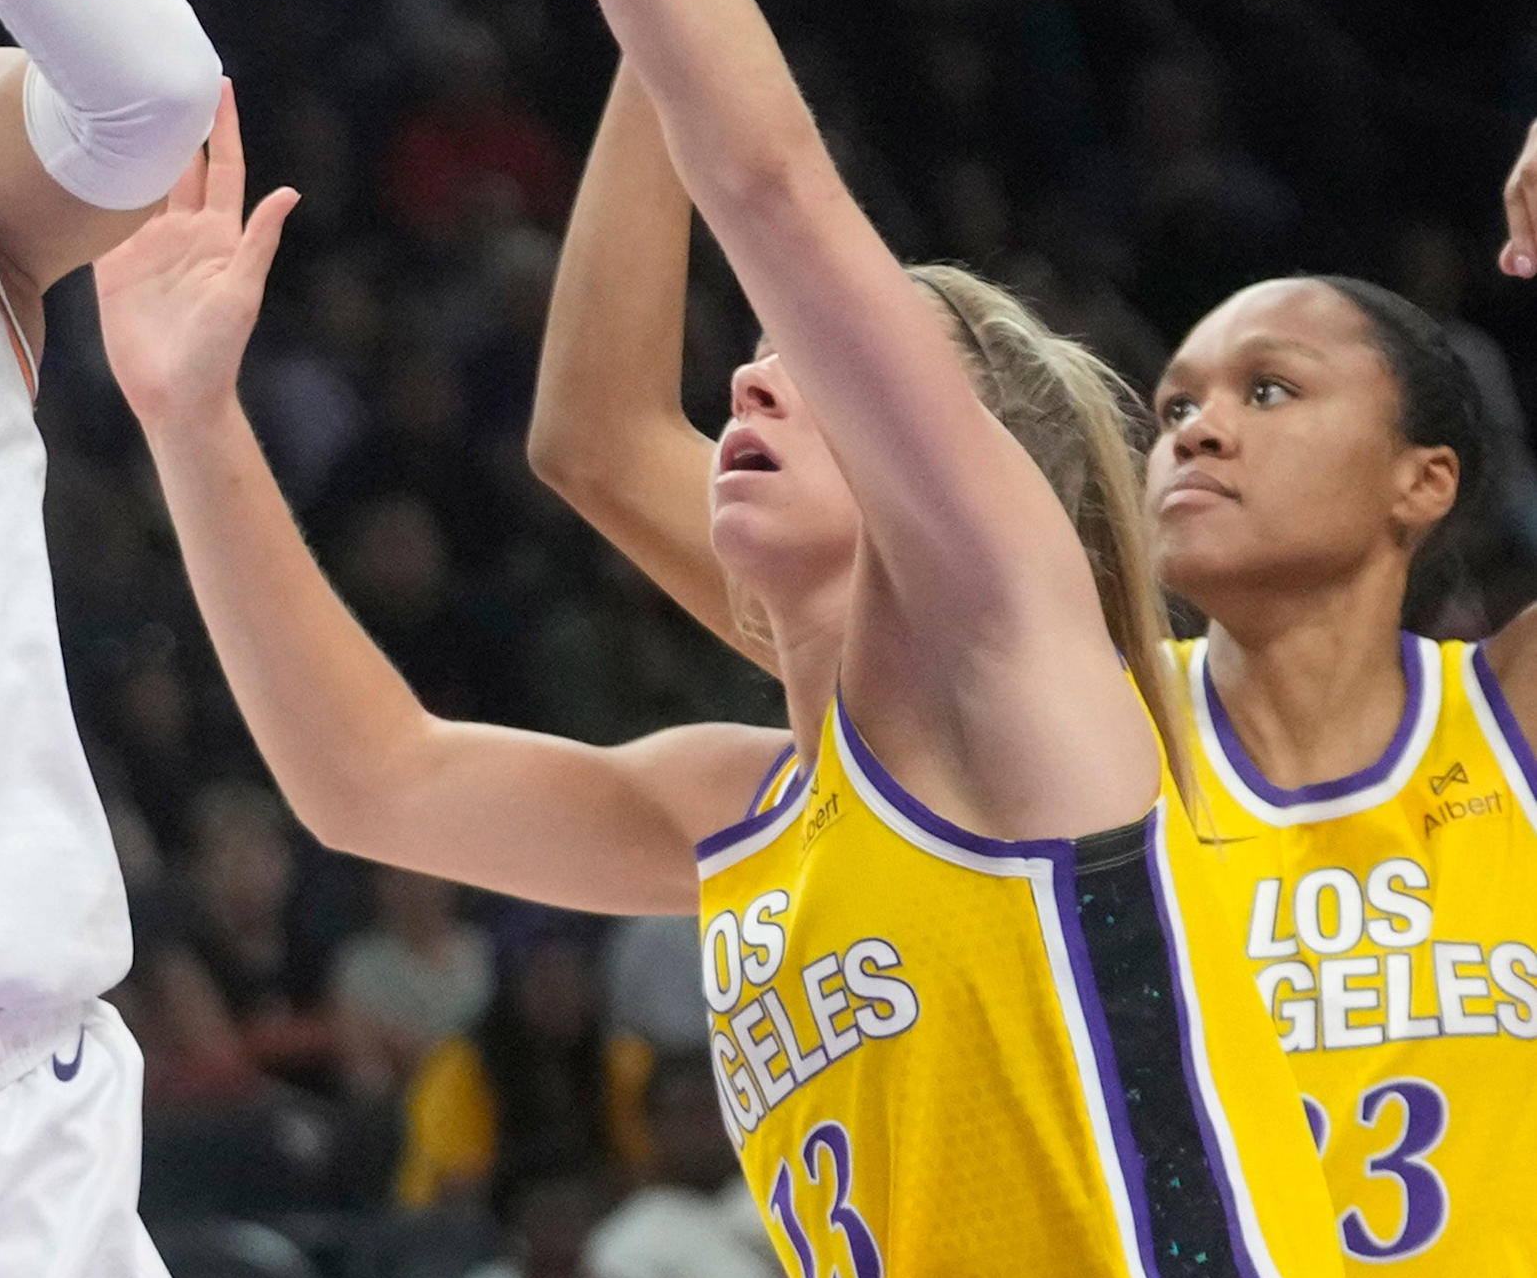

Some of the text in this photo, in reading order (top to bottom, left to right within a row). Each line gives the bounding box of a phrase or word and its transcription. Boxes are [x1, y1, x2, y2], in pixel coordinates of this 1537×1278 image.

[1422, 790, 1503, 839] Albert
[1246, 856, 1434, 960] LOS
[708, 937, 920, 1151] GELES
[1298, 1075, 1451, 1266] 3
